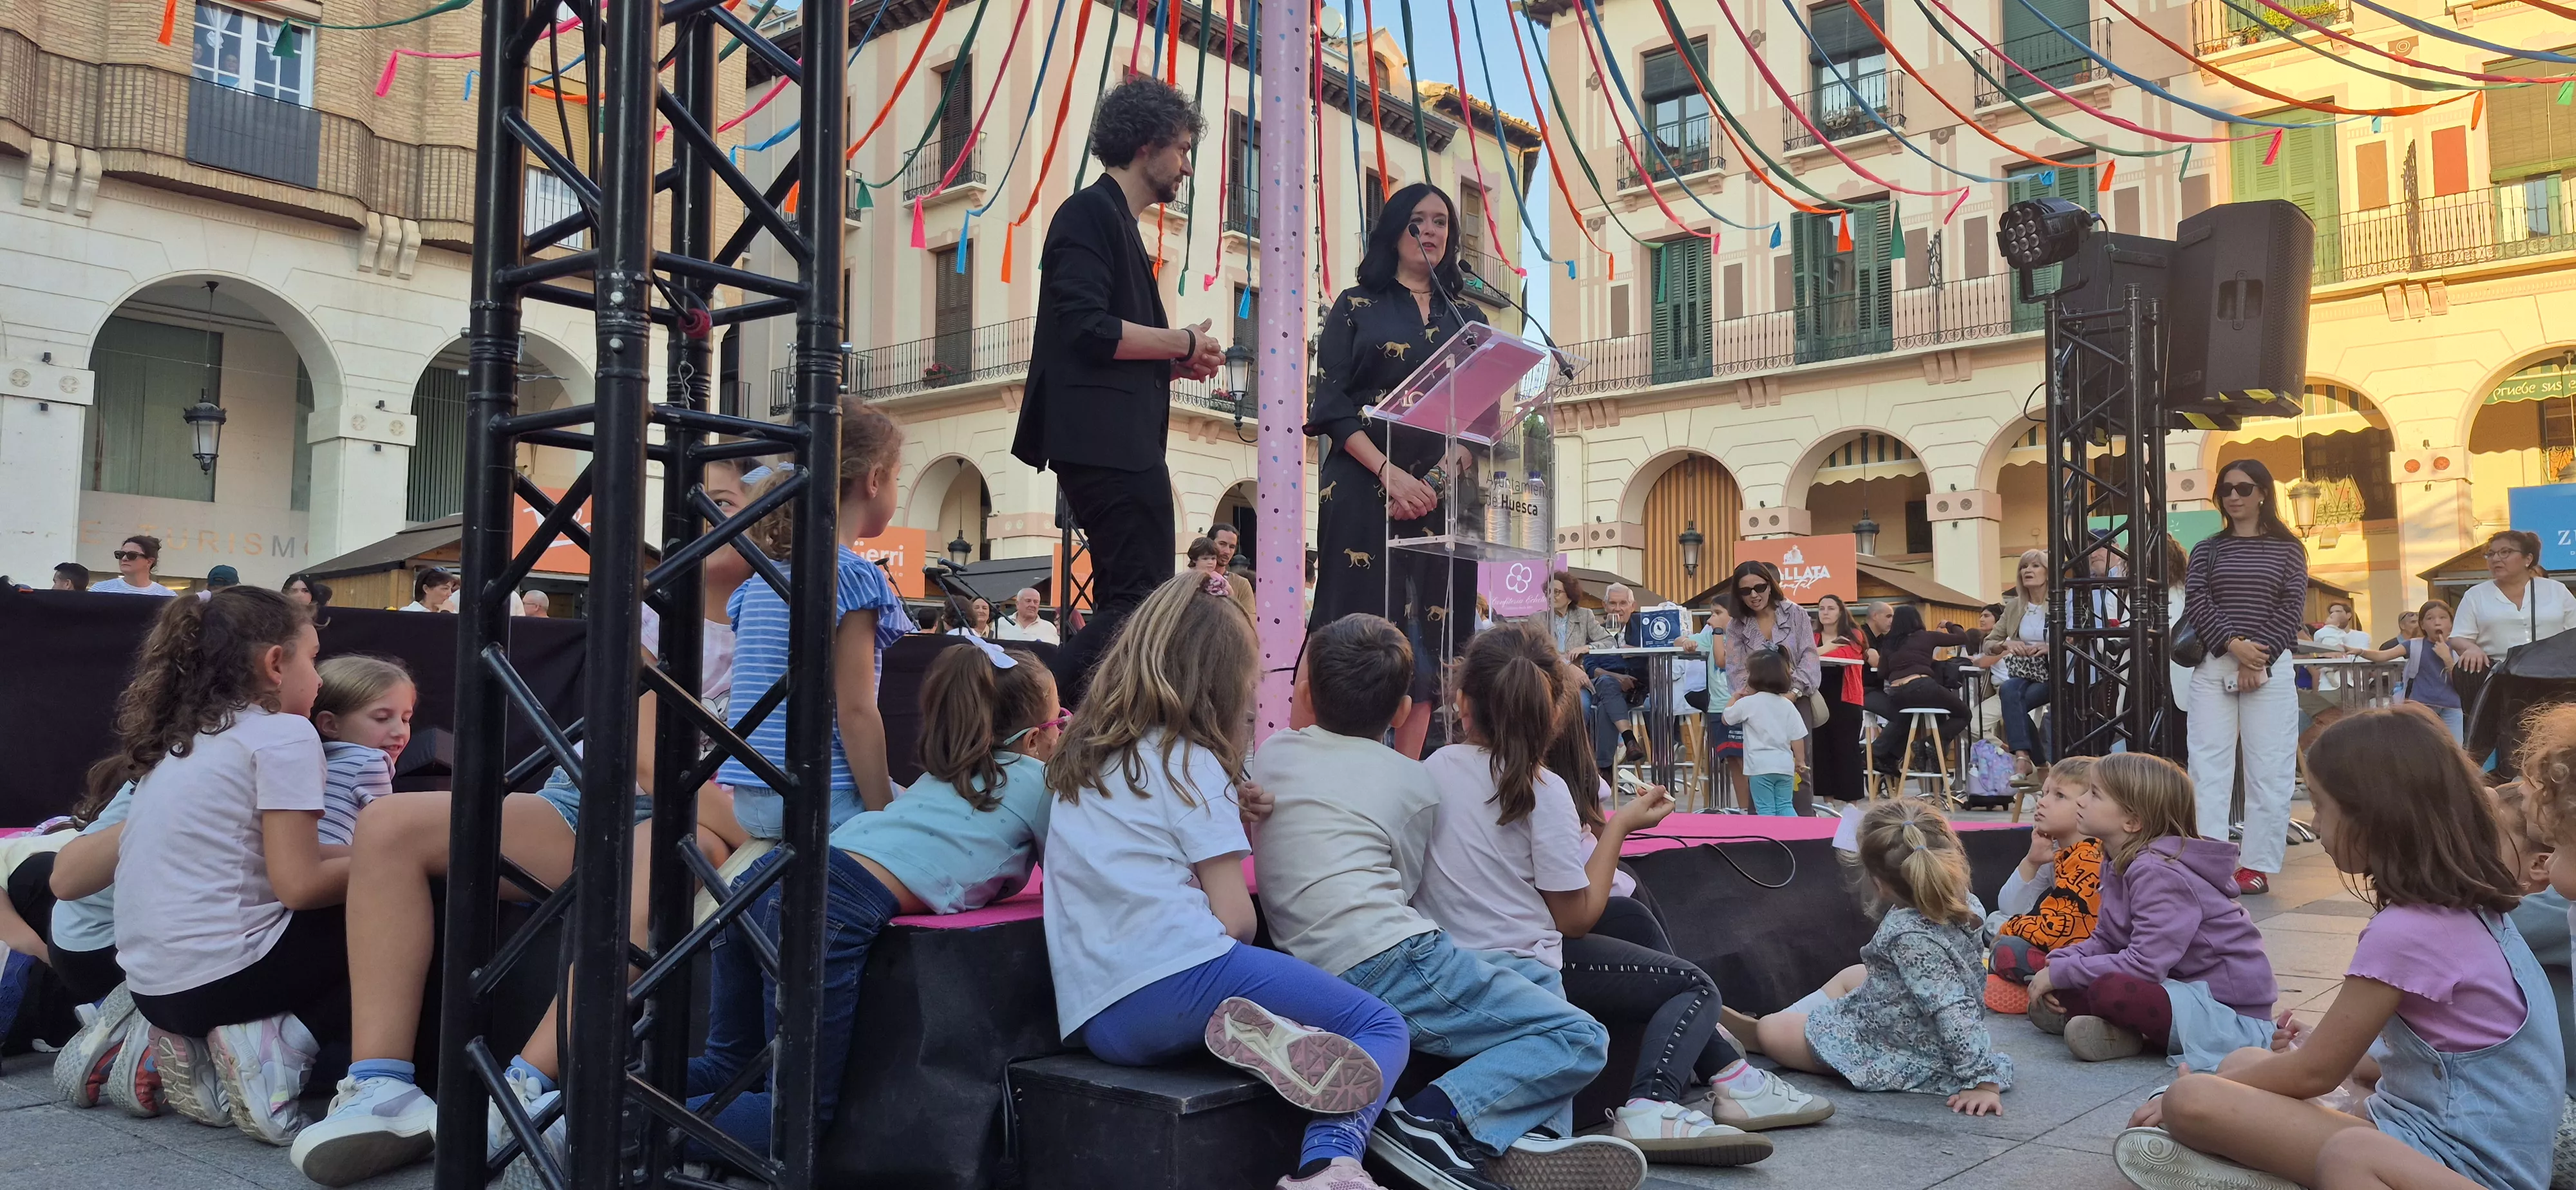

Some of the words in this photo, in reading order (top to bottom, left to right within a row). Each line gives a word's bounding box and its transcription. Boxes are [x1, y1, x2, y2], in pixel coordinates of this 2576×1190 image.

[2493, 381, 2535, 401] pruebe
[2541, 381, 2562, 392] sus
[1486, 470, 1554, 500] Ayuntamiento
[1486, 492, 1498, 507] de
[1501, 494, 1538, 516] Huesca
[138, 524, 308, 558] TURISM
[1688, 999, 1701, 1015] AIR
[1674, 1019, 1687, 1037] AIR
[1662, 1043, 1674, 1063] AIR
